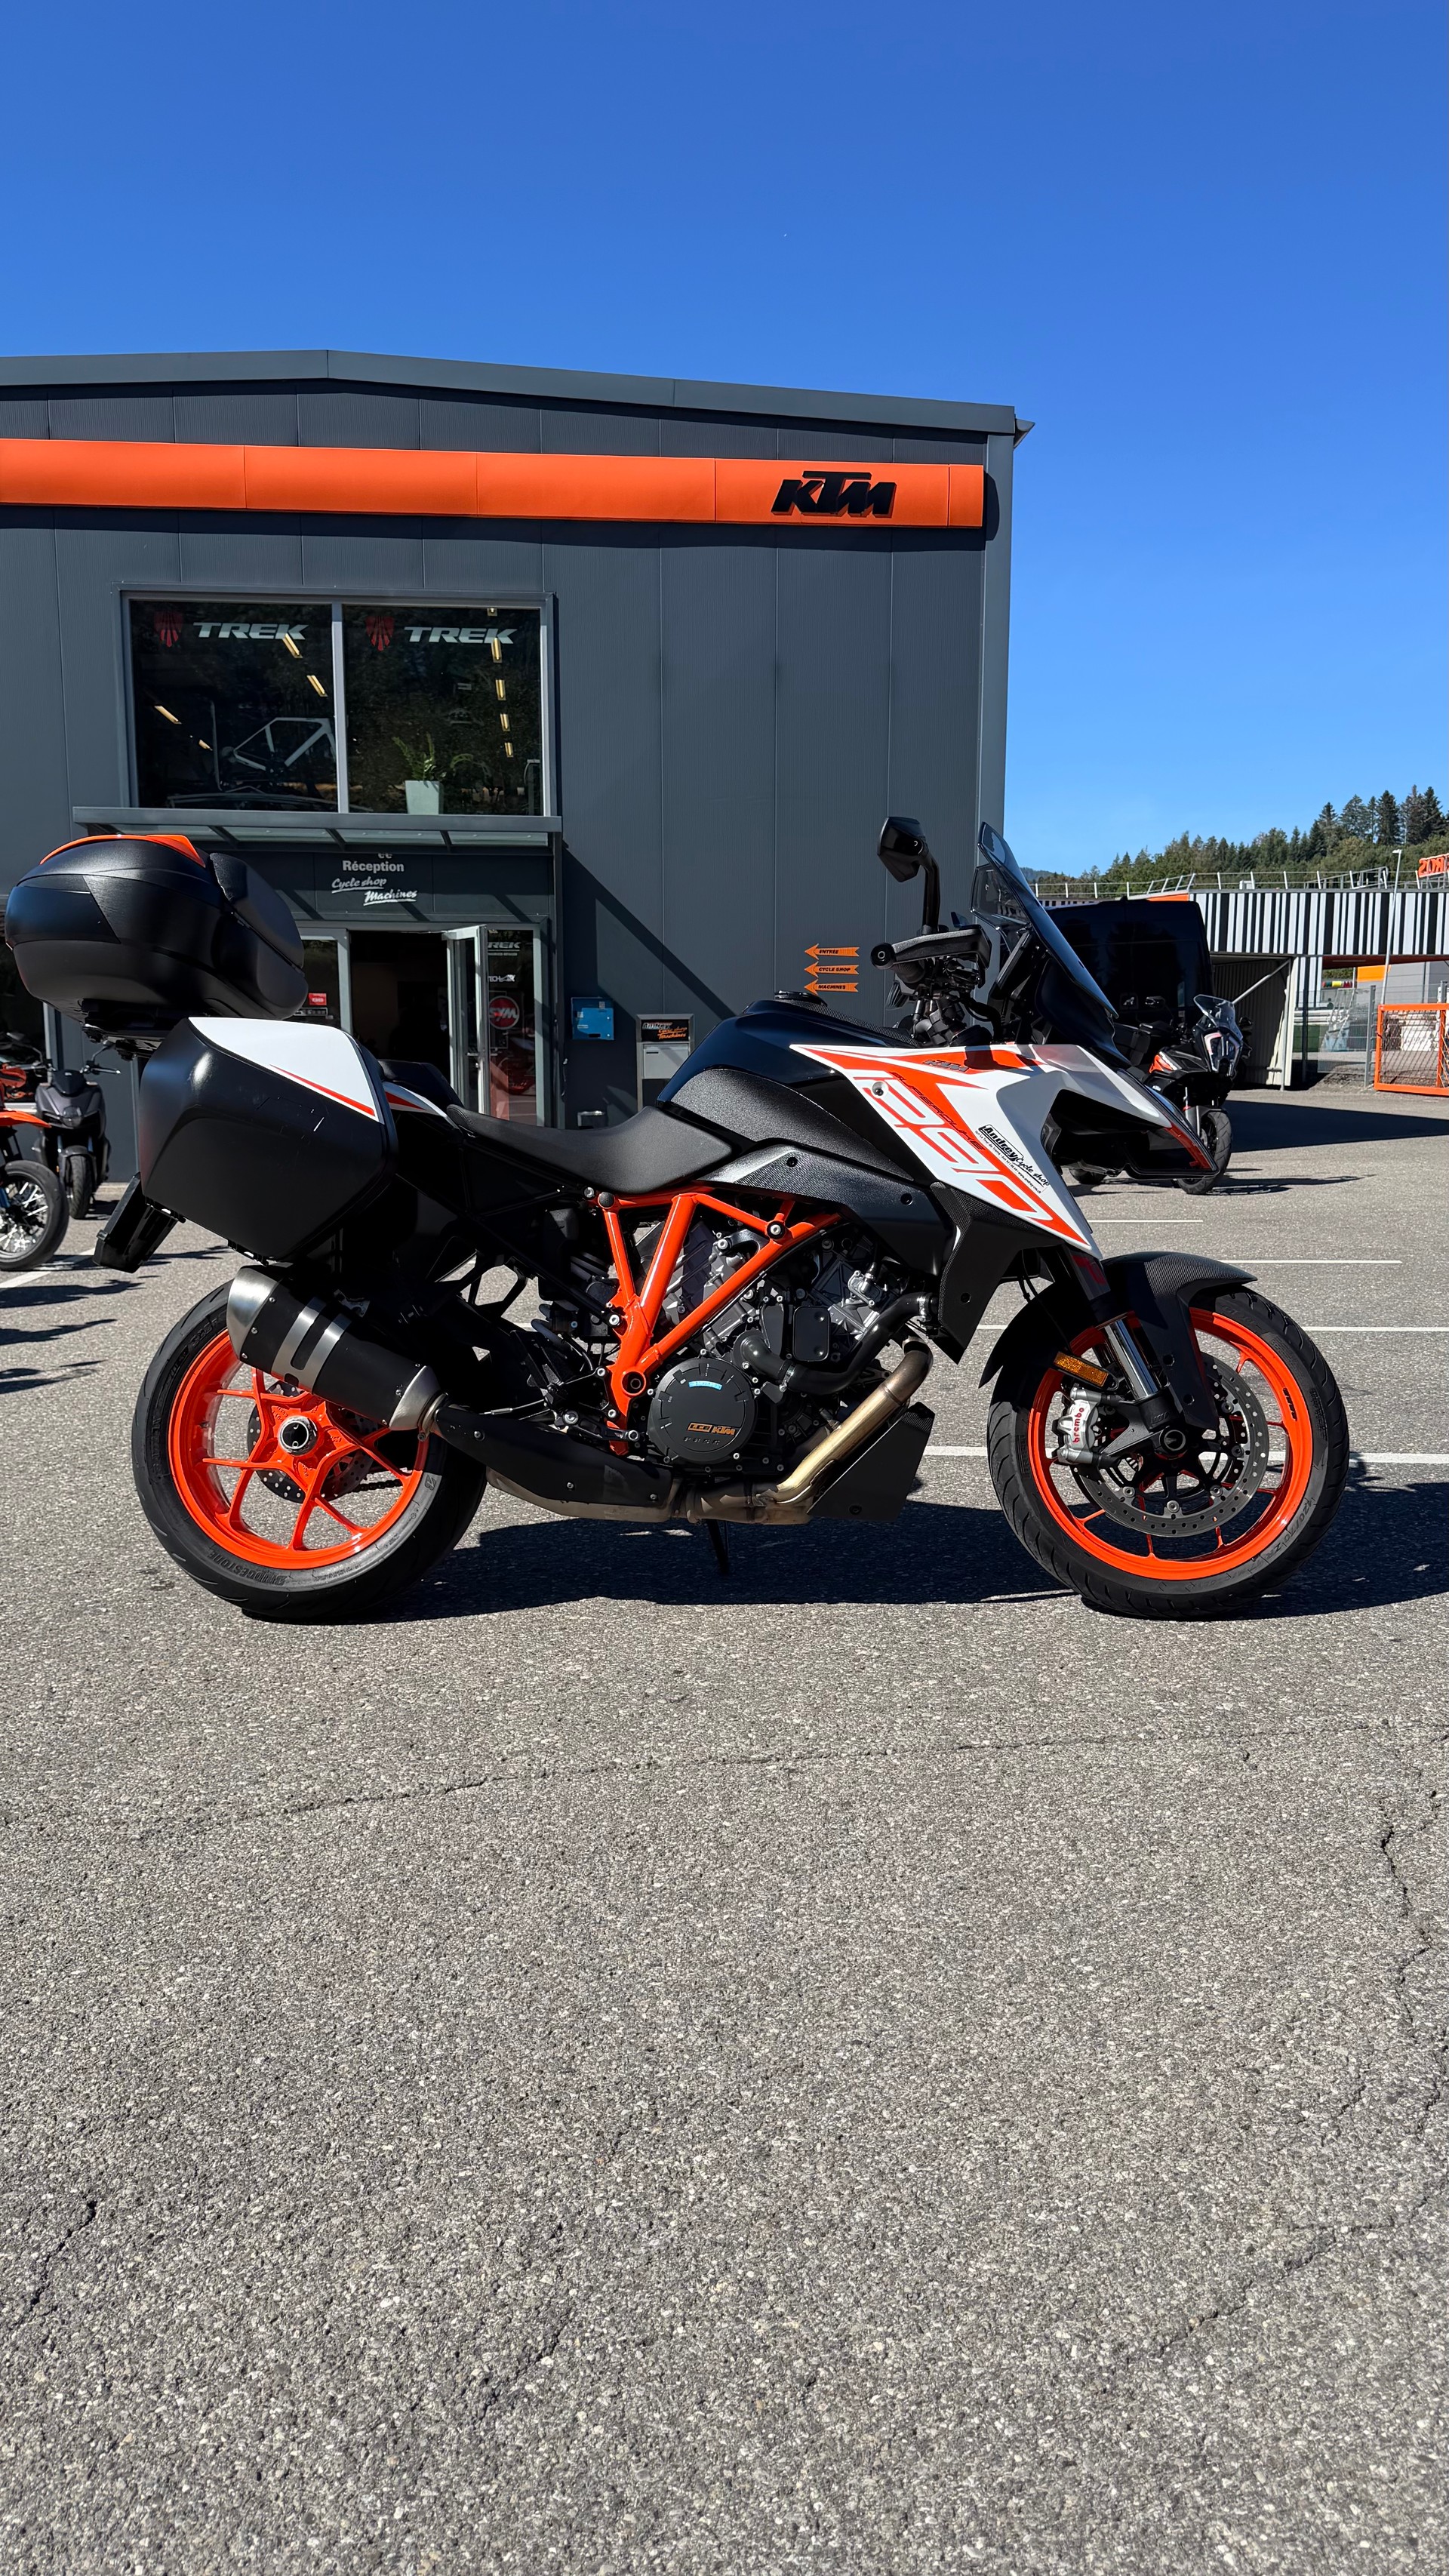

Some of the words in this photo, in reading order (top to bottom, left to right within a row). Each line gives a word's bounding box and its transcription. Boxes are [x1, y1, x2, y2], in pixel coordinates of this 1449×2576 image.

[771, 470, 897, 518] KTM
[193, 622, 309, 640] TREK
[404, 626, 518, 644] TREK
[342, 860, 405, 873] Réception
[331, 877, 360, 891] Cycle
[361, 876, 387, 887] shop
[364, 889, 417, 903] Machines
[489, 1008, 518, 1021] SYM
[923, 1059, 969, 1072] KTM
[983, 1127, 1019, 1161] Andrey
[1016, 1158, 1034, 1173] Cycle
[1033, 1173, 1050, 1186] shop
[712, 1425, 736, 1436] KTM
[1072, 1407, 1084, 1443] brembo
[207, 1550, 288, 1587] BRIDGESTONE
